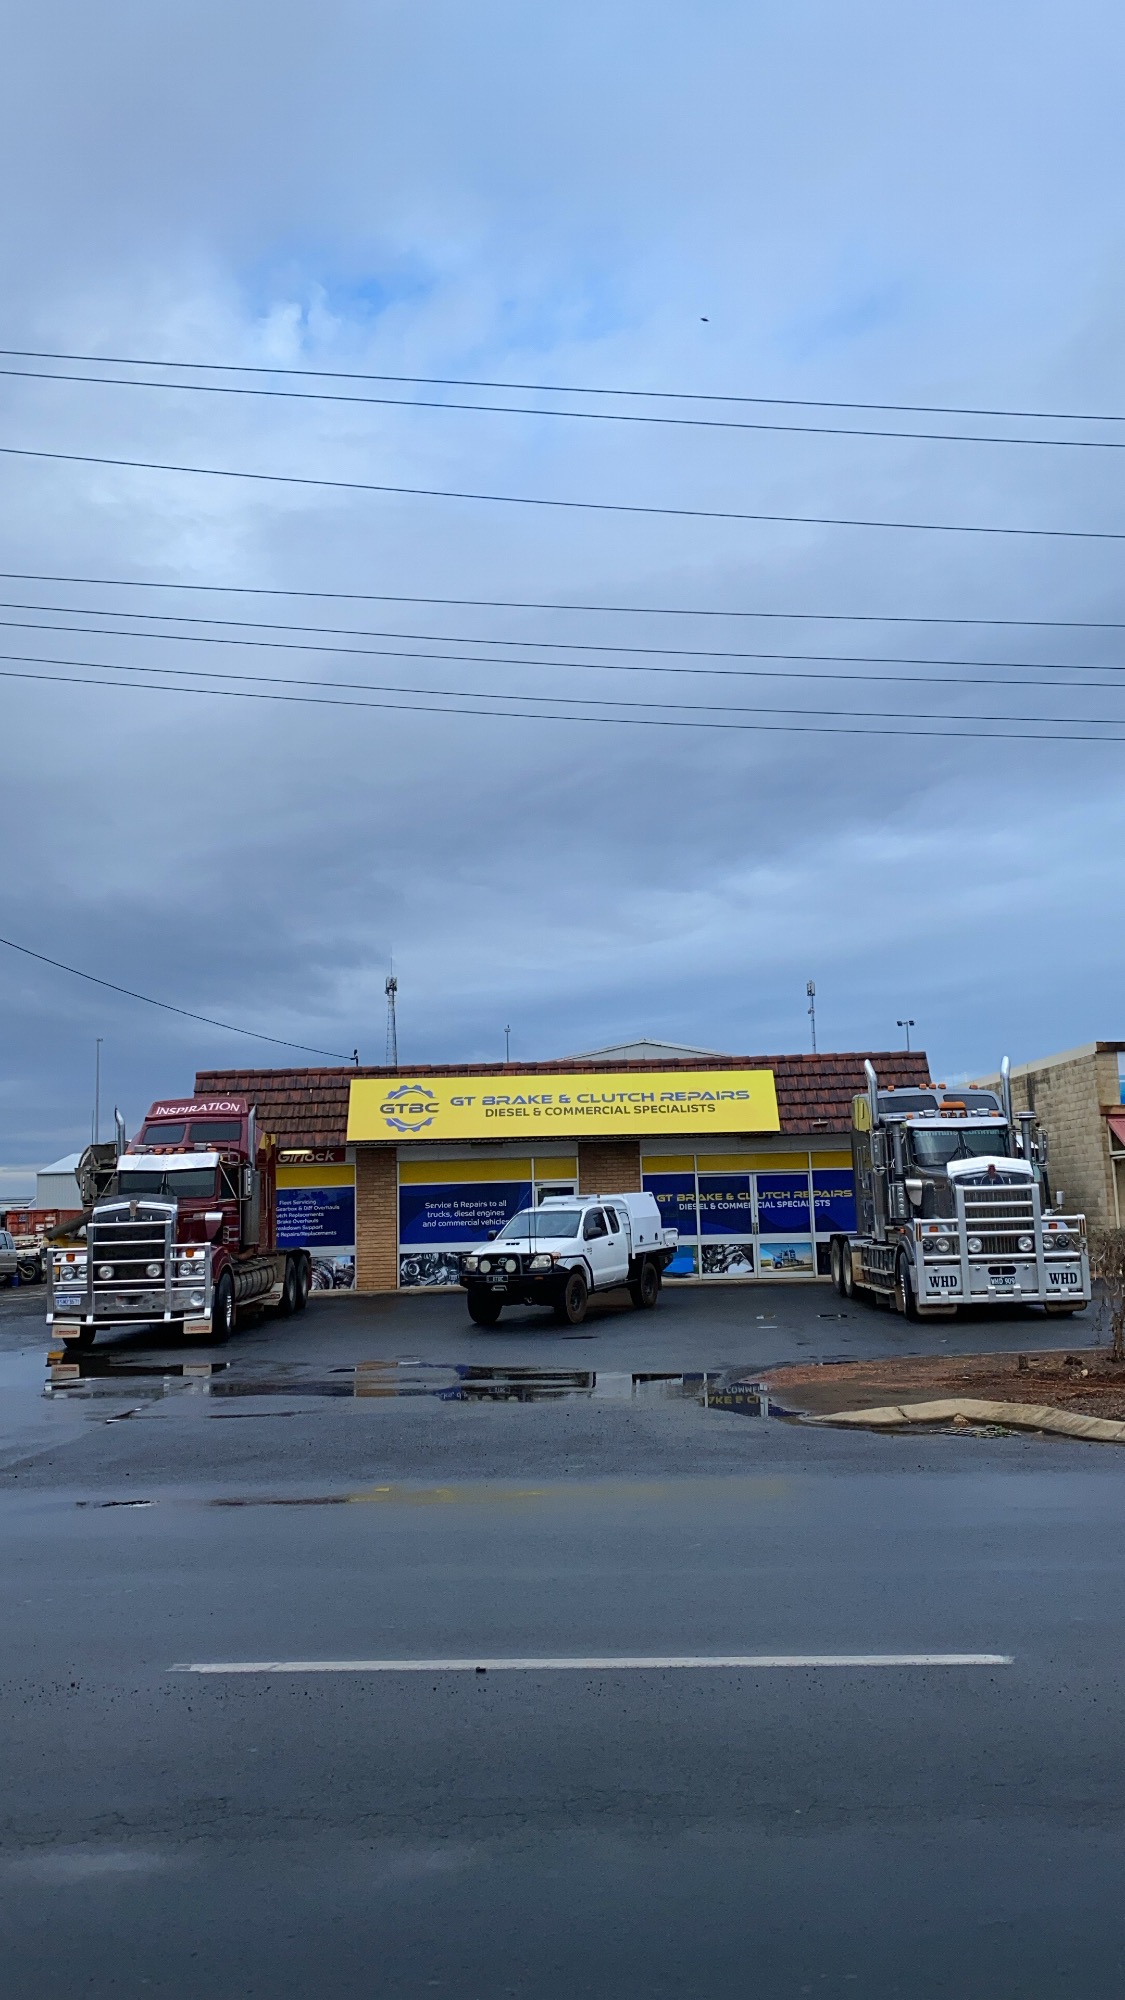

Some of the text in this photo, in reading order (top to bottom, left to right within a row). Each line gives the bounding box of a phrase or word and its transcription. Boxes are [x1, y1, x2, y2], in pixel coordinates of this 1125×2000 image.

[450, 1090, 750, 1106] GT BRAKE & CLUTCH REPAIRS
[156, 1102, 240, 1115] INSPIRATION
[380, 1103, 439, 1114] GTBC
[485, 1103, 716, 1117] DIESEL & COMMERCIAL SPECIALISTS
[656, 1194, 673, 1202] GT
[677, 1193, 722, 1201] BRAKE
[726, 1192, 734, 1200] &
[794, 1190, 853, 1198] REPAIRS
[718, 1201, 775, 1209] COMMECIAL
[777, 1200, 830, 1208] SPECIALSTS
[477, 1210, 505, 1218] engines
[422, 1220, 437, 1228] and
[438, 1219, 480, 1227] commercial
[929, 1276, 958, 1288] WHD
[1049, 1272, 1078, 1284] WHD
